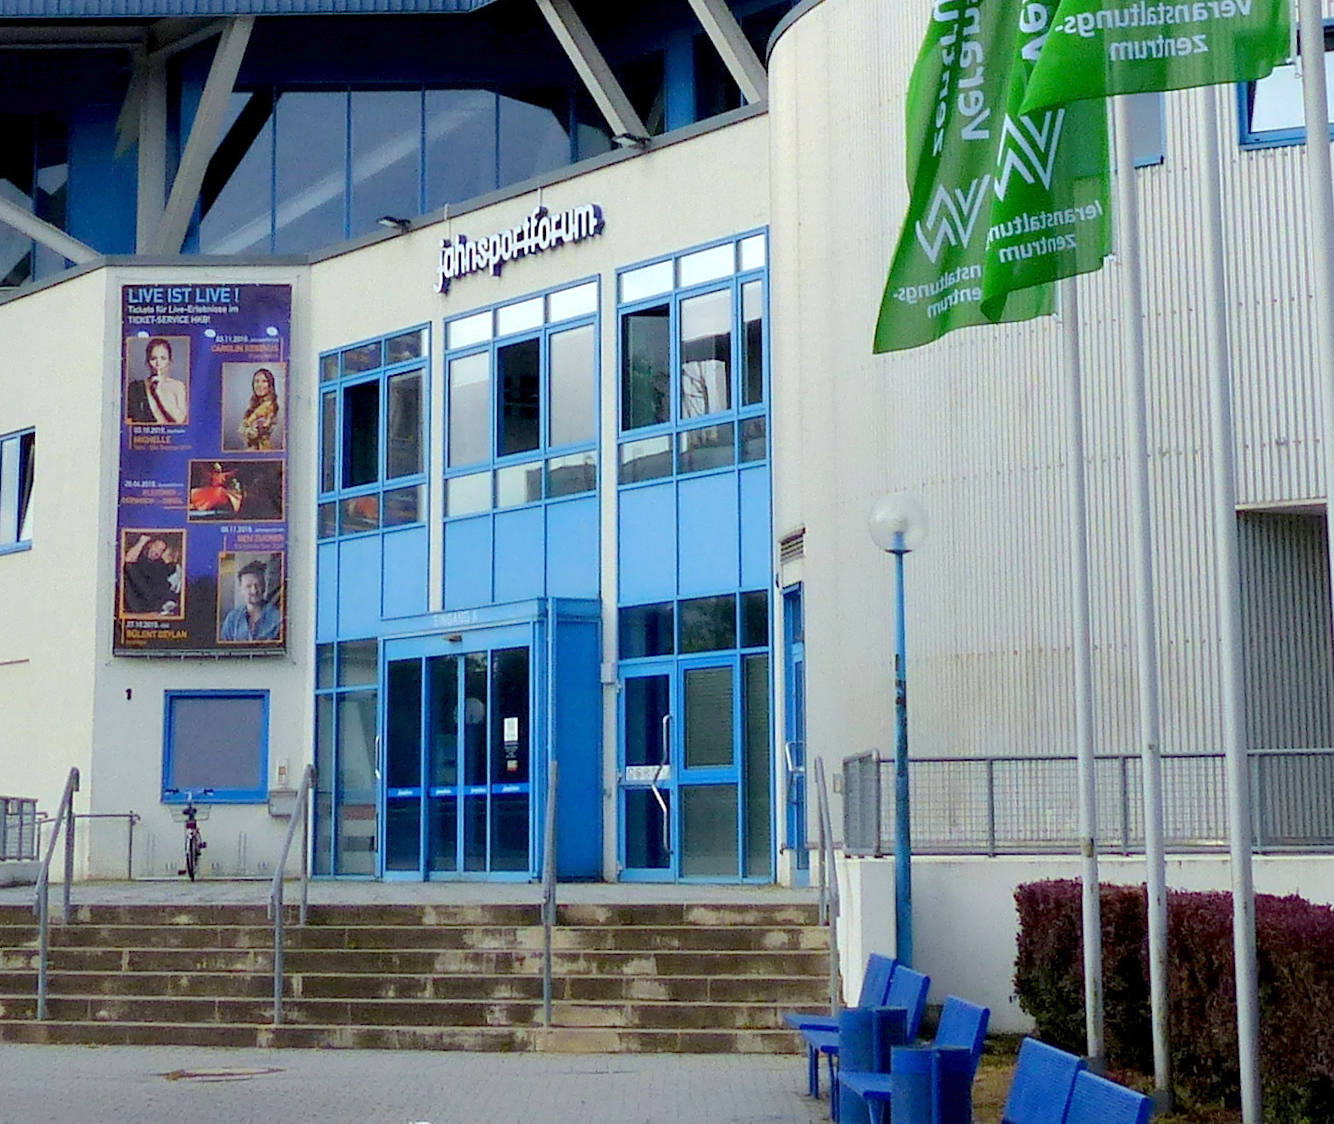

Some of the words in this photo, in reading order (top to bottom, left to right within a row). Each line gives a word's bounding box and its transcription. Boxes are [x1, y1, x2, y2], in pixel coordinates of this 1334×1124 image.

[433, 204, 601, 294] jahnsportforum
[128, 287, 164, 303] LIVE
[167, 287, 192, 303] IST
[196, 287, 230, 303] LIVE
[125, 688, 132, 701] 1
